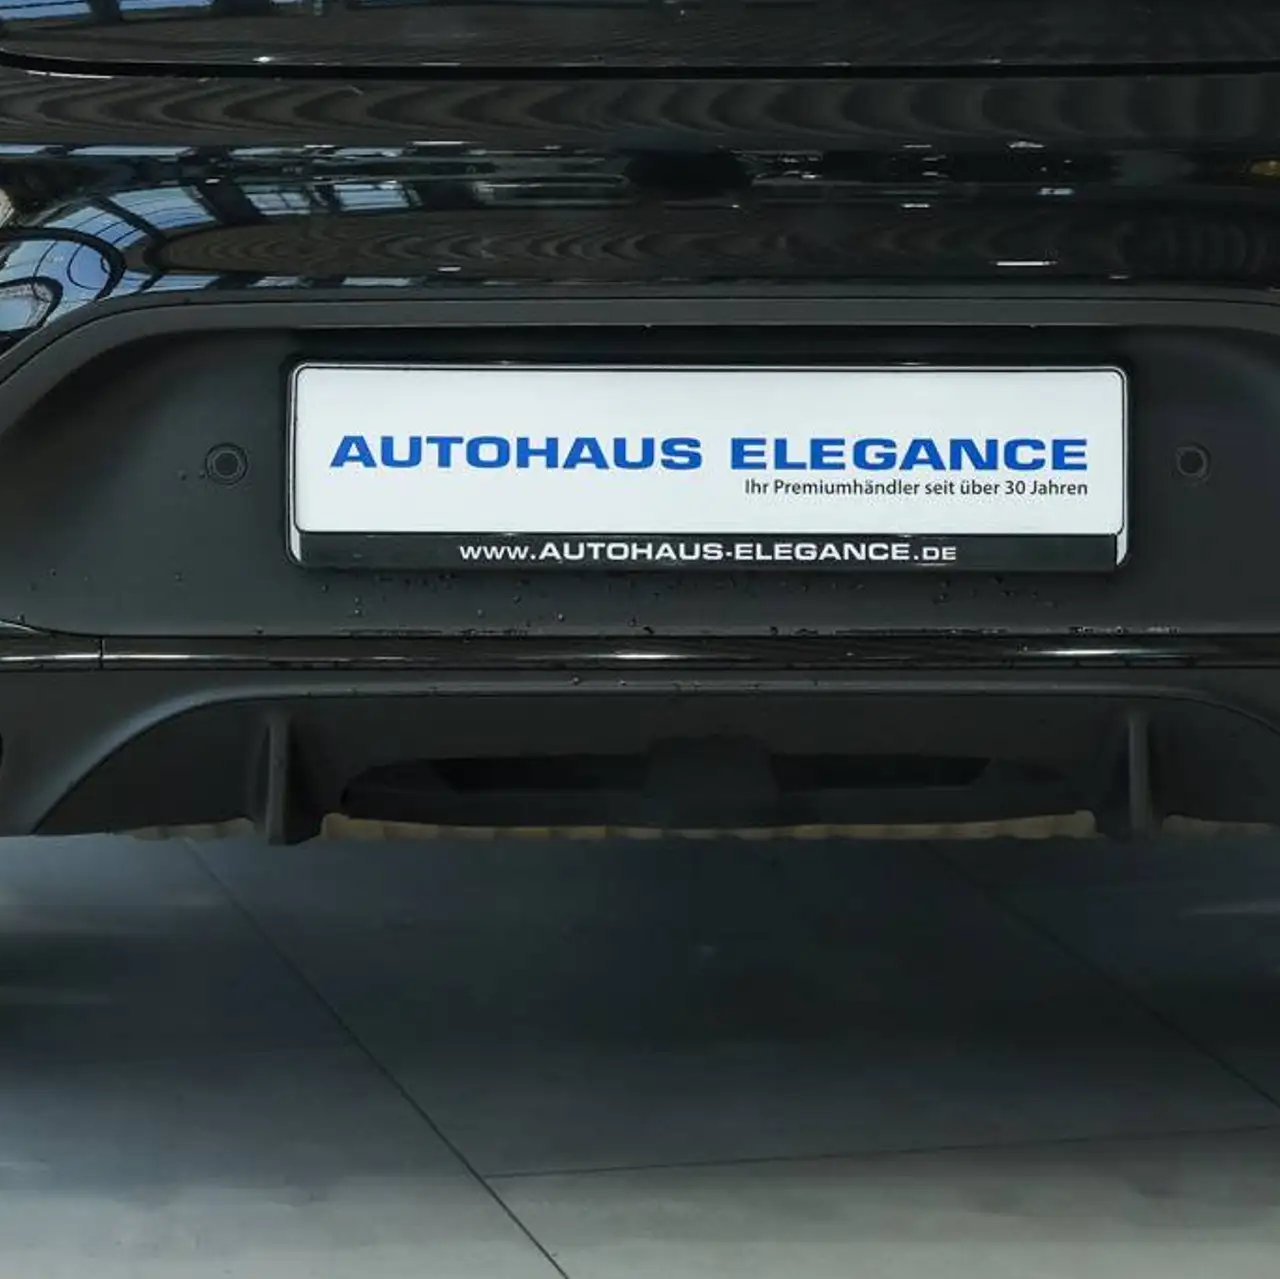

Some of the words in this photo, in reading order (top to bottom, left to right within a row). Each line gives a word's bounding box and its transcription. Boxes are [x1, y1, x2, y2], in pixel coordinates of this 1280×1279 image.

[330, 435, 703, 470] AUTOHAUS
[730, 437, 1088, 471] ELEGANCE
[744, 478, 769, 495] Ihr
[773, 478, 921, 496] Premiumhändler
[923, 478, 955, 495] seit
[959, 478, 1001, 495] über
[1005, 480, 1027, 495] 30
[1029, 478, 1089, 495] Jahren
